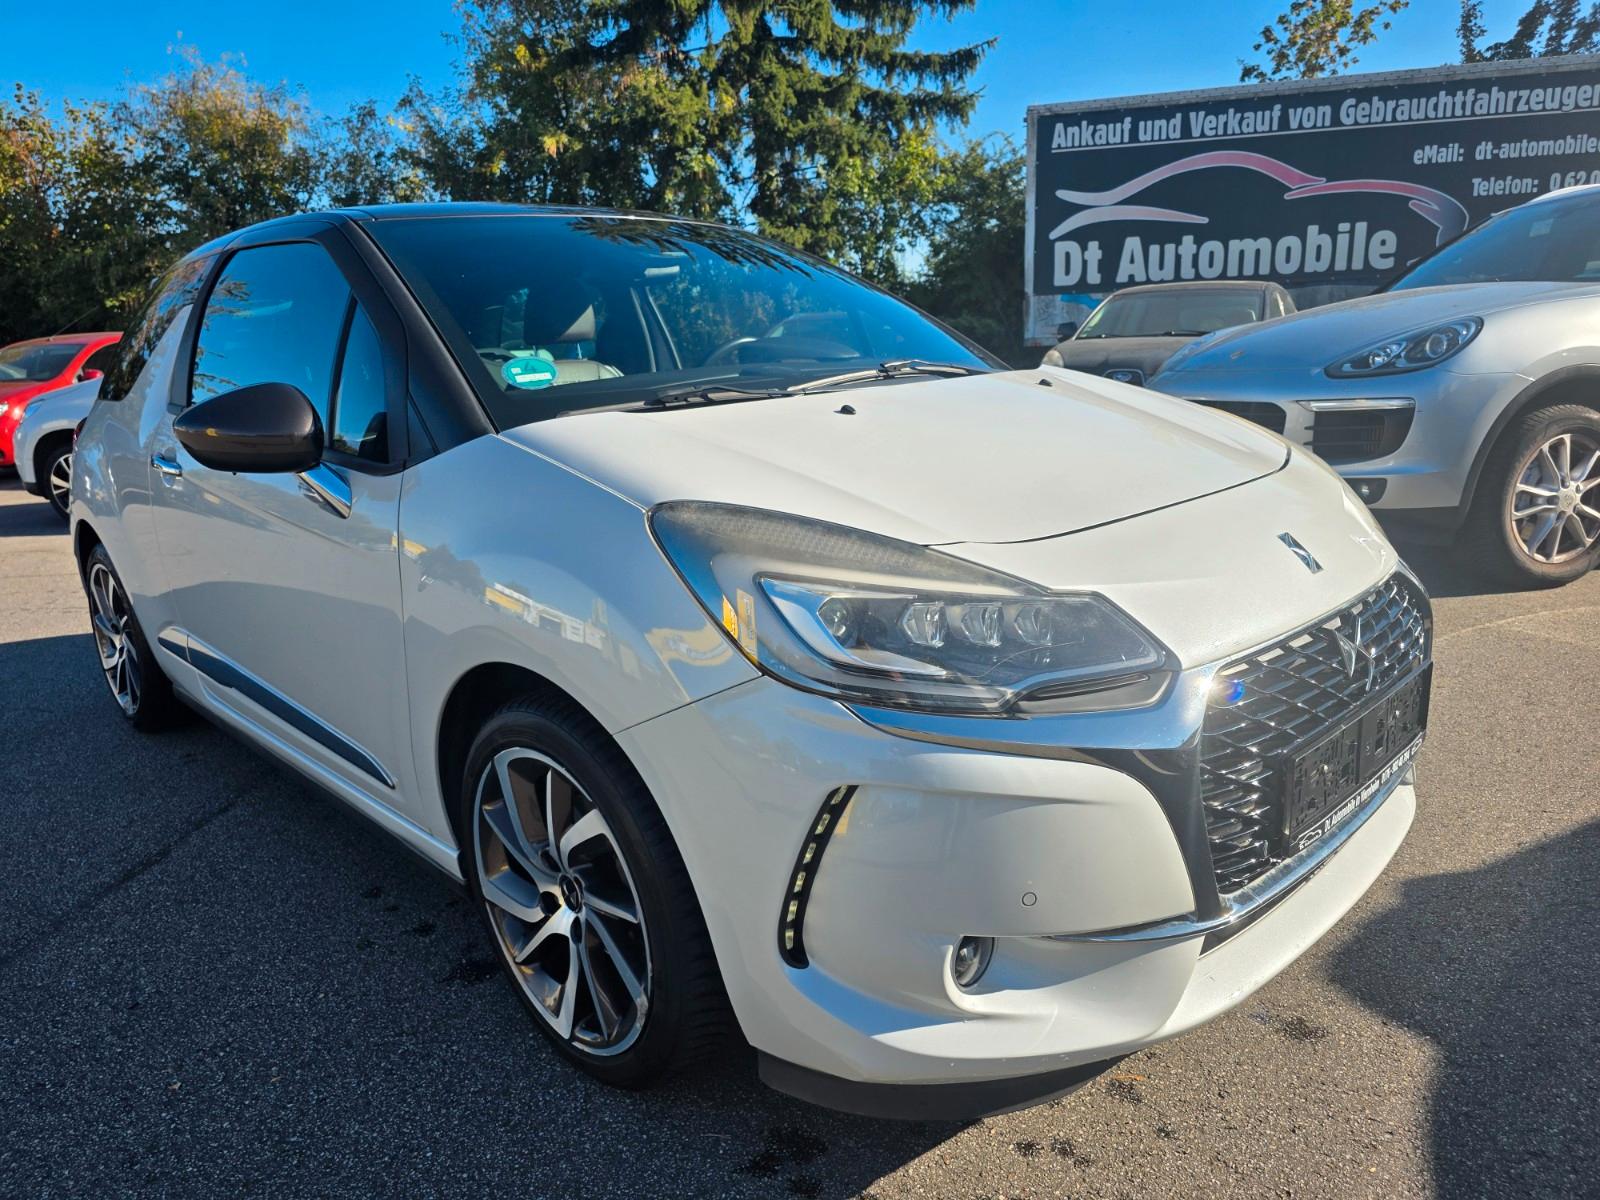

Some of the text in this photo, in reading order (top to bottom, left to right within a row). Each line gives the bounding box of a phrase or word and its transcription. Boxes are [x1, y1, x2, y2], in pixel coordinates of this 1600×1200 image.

[1051, 116, 1132, 149] Ankauf
[1138, 112, 1182, 142] und
[1189, 104, 1282, 138] Verkauf
[1288, 104, 1332, 129] von
[1413, 133, 1600, 165] eMail: dt-automobile
[1472, 175, 1539, 197] Telefon:
[1053, 221, 1397, 287] Dt Automobile
